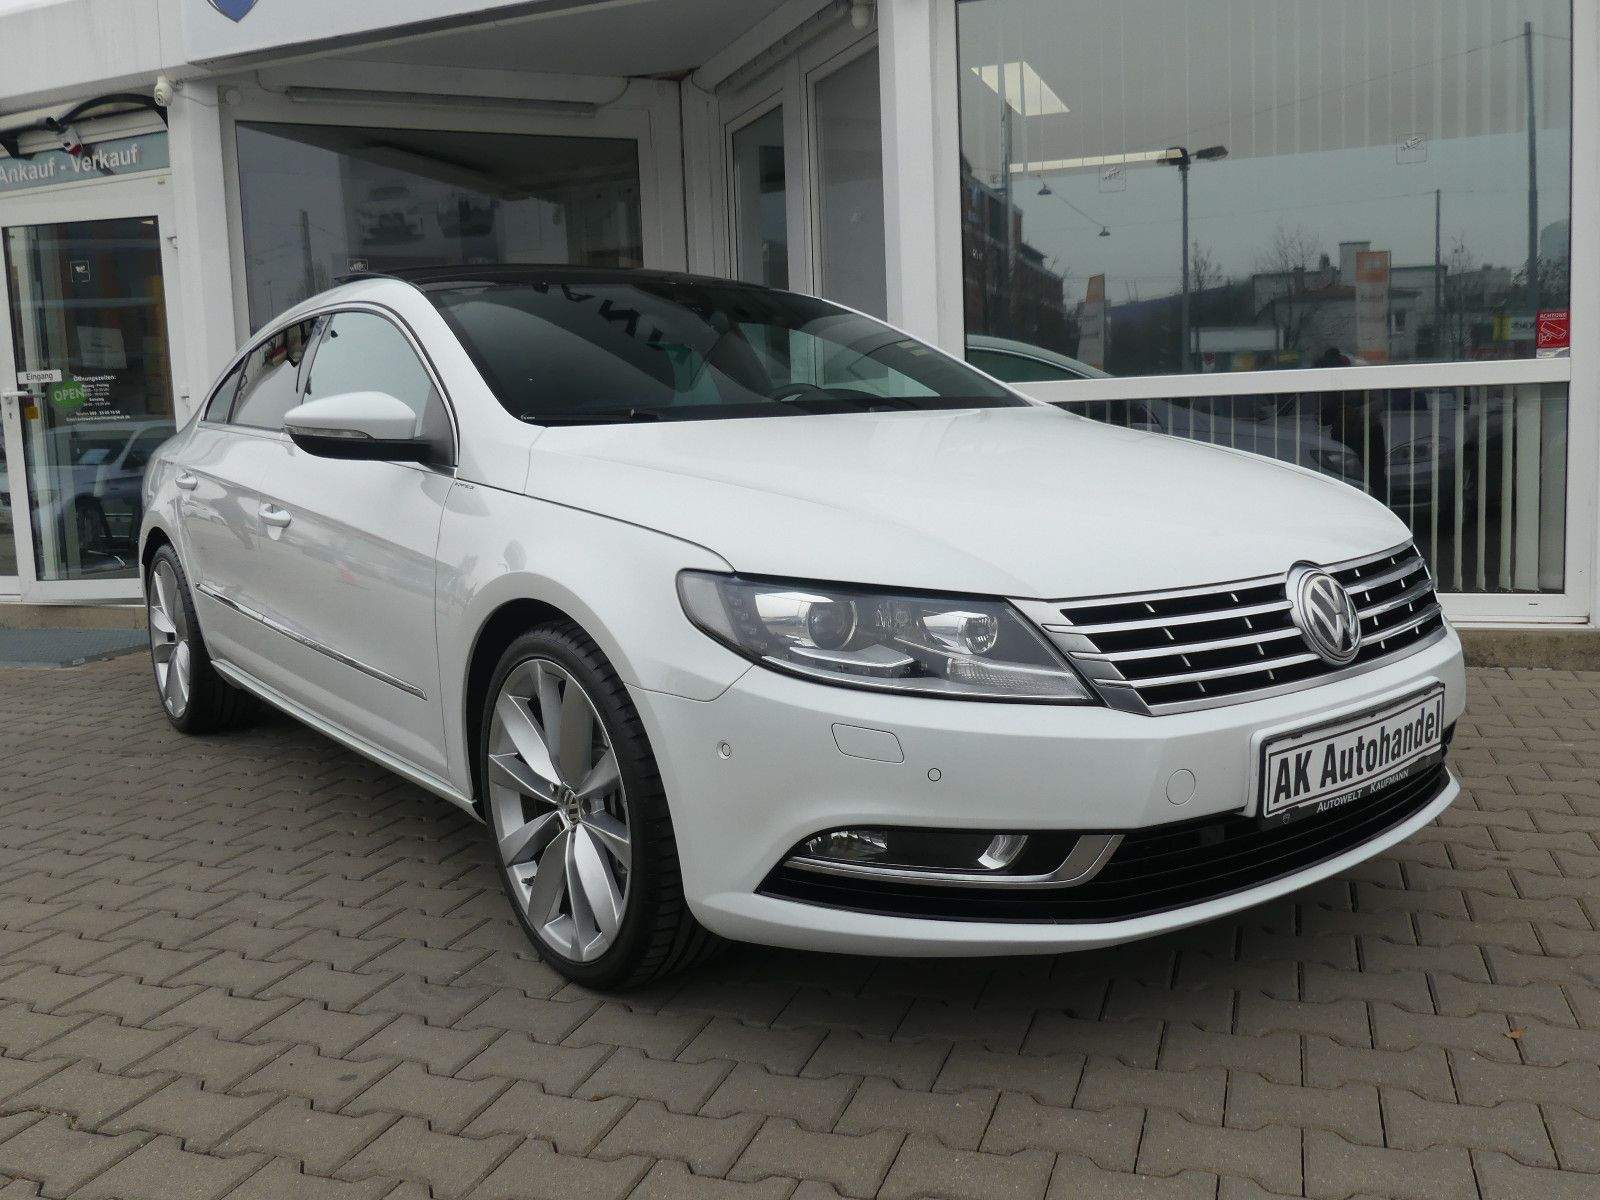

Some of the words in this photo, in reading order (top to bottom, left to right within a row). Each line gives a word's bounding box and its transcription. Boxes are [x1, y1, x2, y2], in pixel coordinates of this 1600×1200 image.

[0, 157, 56, 184] Ankauf
[70, 143, 139, 173] Verkauf
[26, 373, 53, 381] Eingang
[54, 388, 85, 401] OPEN
[1273, 750, 1312, 804] AK
[1320, 700, 1441, 789] Autohandel
[1317, 789, 1363, 814] AUTOWELT
[1370, 769, 1409, 795] KAUFMANN
